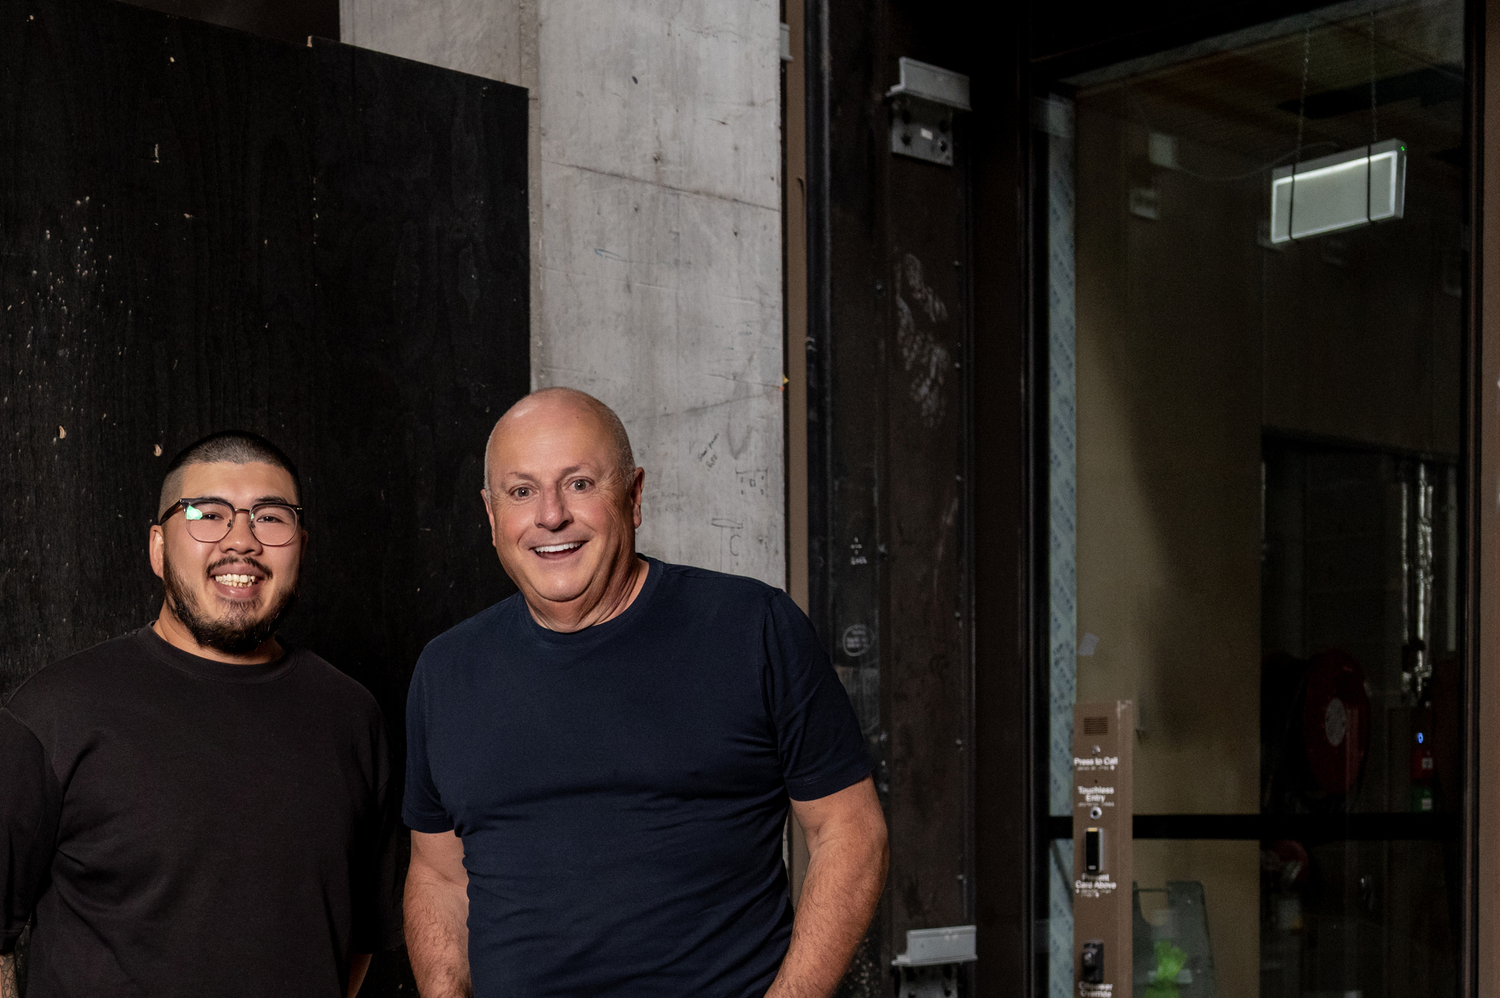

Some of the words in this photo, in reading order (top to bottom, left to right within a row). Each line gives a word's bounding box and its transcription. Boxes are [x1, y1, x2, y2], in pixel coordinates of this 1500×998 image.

[1074, 757, 1094, 766] Press
[1095, 757, 1103, 766] to
[1103, 756, 1118, 766] Call
[1078, 786, 1114, 795] Touchless
[1085, 794, 1106, 803] Entry
[1075, 880, 1093, 889] Card
[1094, 881, 1117, 889] Above
